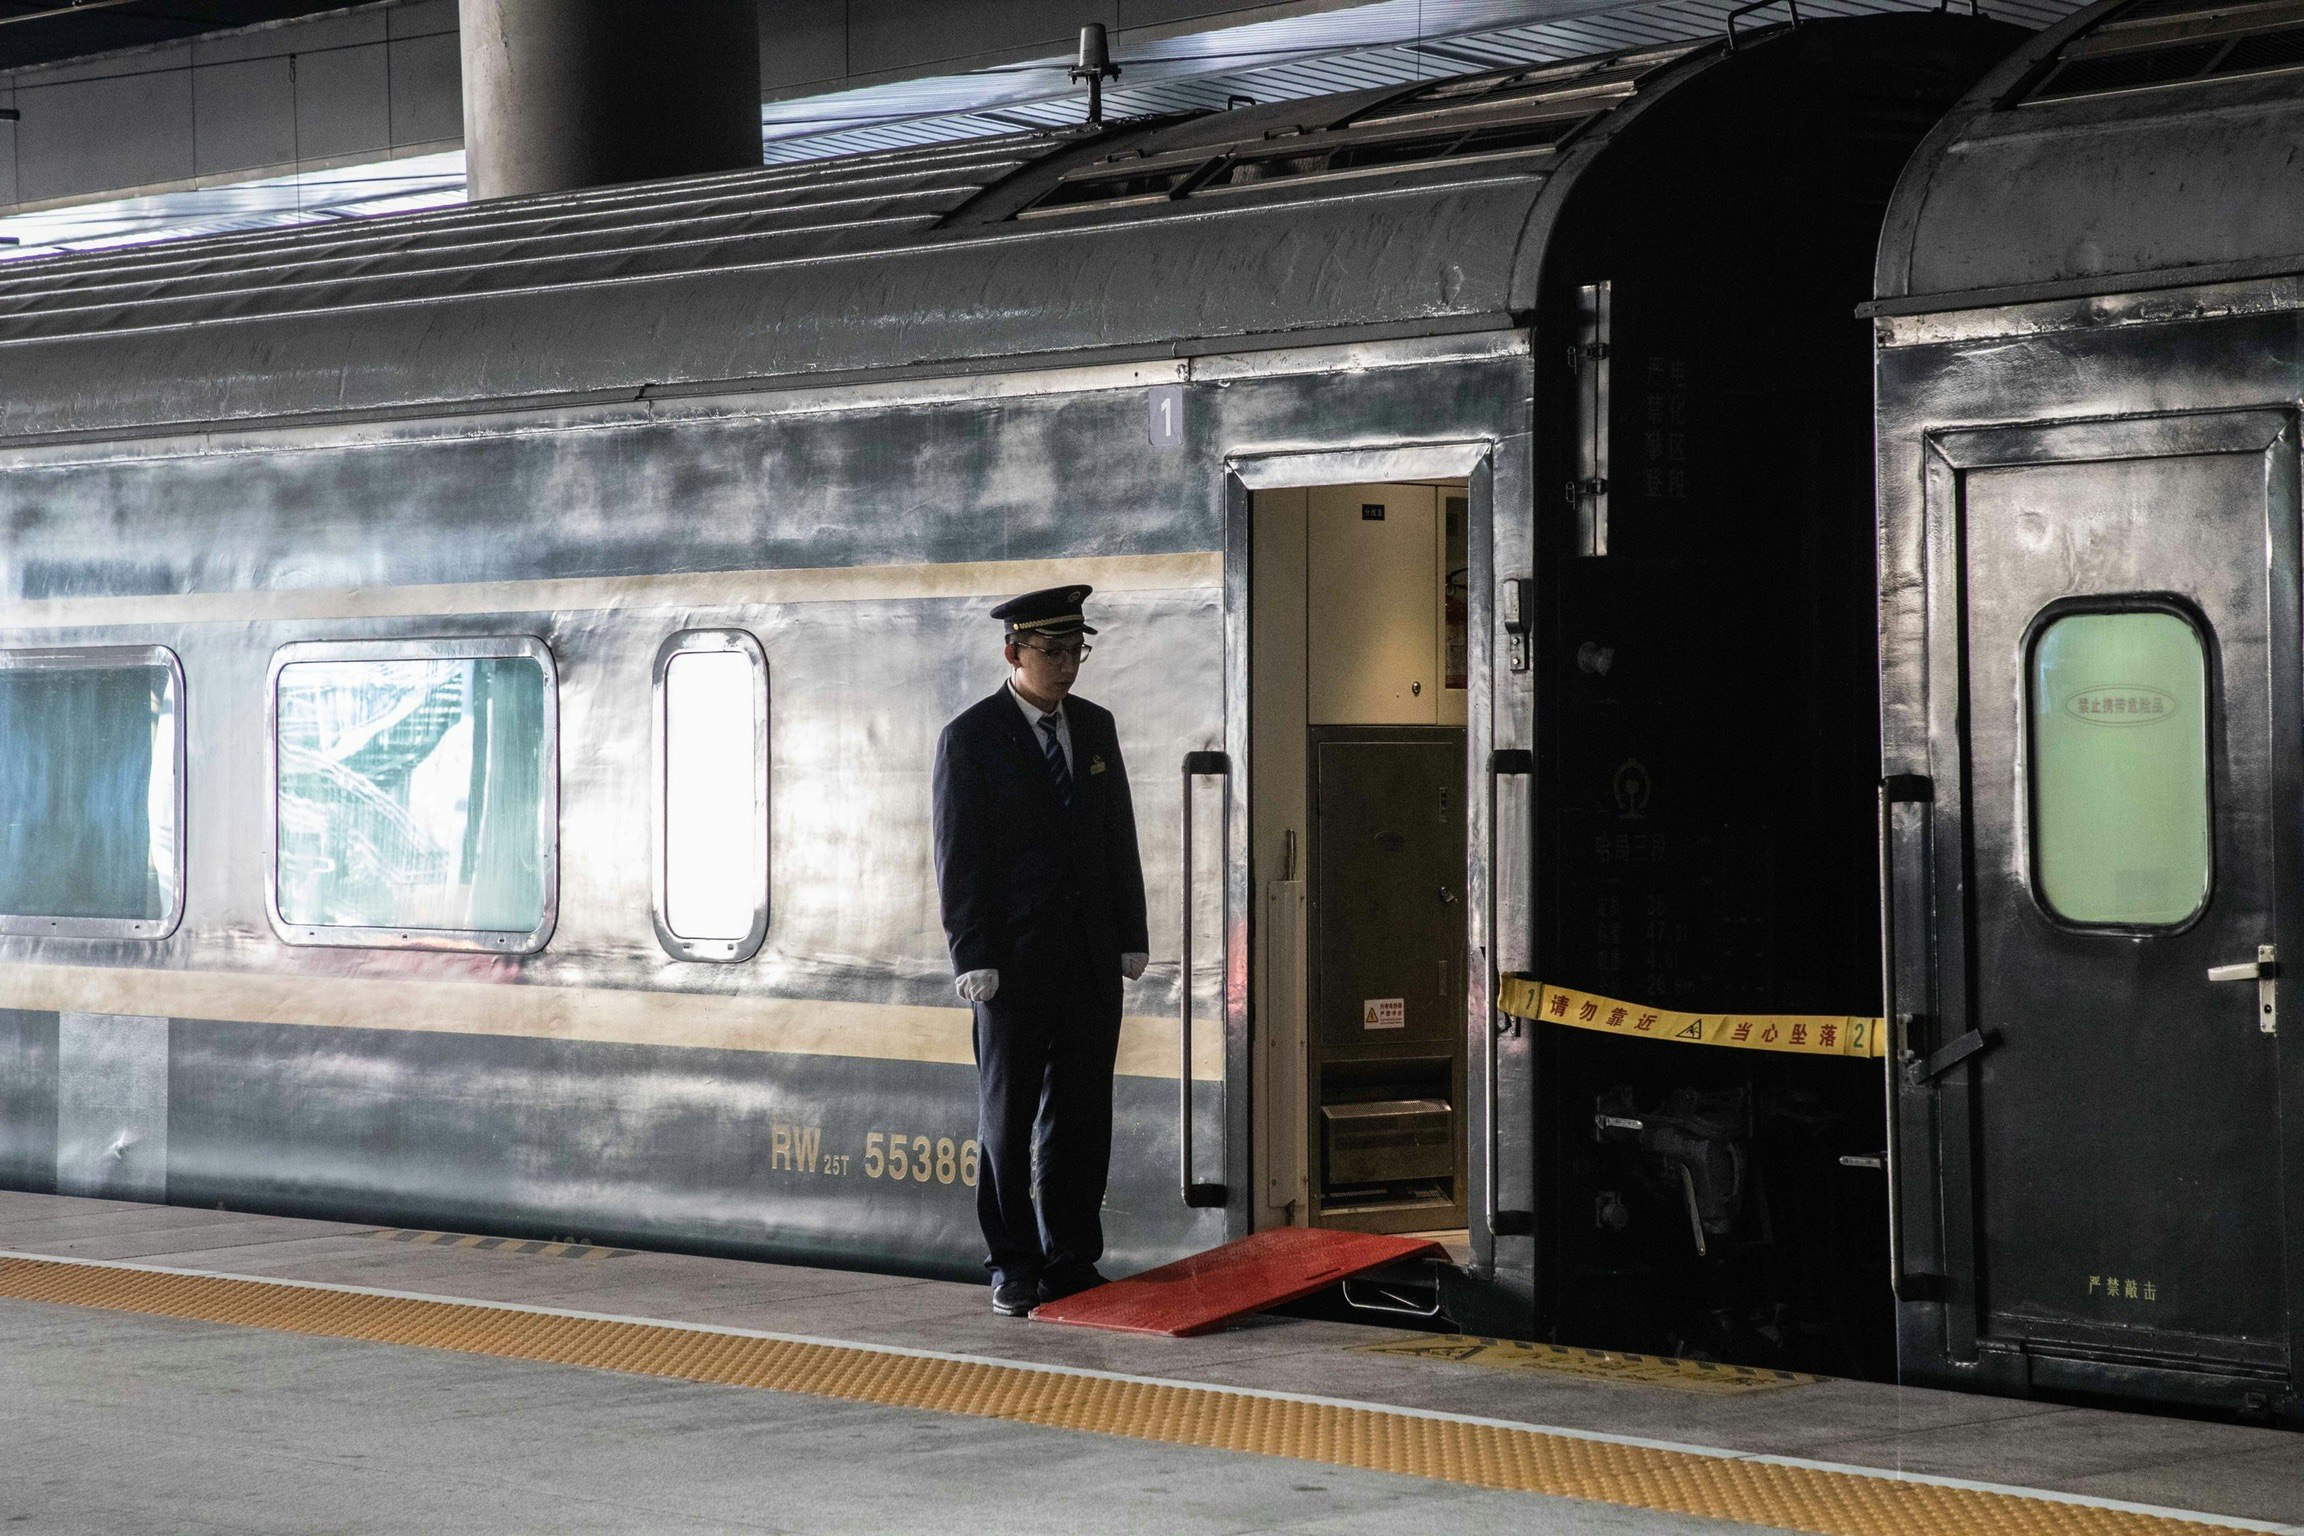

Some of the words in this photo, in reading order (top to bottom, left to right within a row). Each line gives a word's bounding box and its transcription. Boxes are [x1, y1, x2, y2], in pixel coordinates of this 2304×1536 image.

[1161, 397, 1171, 437] 1
[1550, 994, 1658, 1032] 请勿靠近
[1731, 1021, 1837, 1048] 当心坠落
[1853, 1023, 1865, 1049] 2
[771, 1122, 821, 1173] RW
[824, 1154, 850, 1177] 25T
[864, 1131, 978, 1187] 55386
[2088, 1275, 2157, 1301] 严禁敲击
